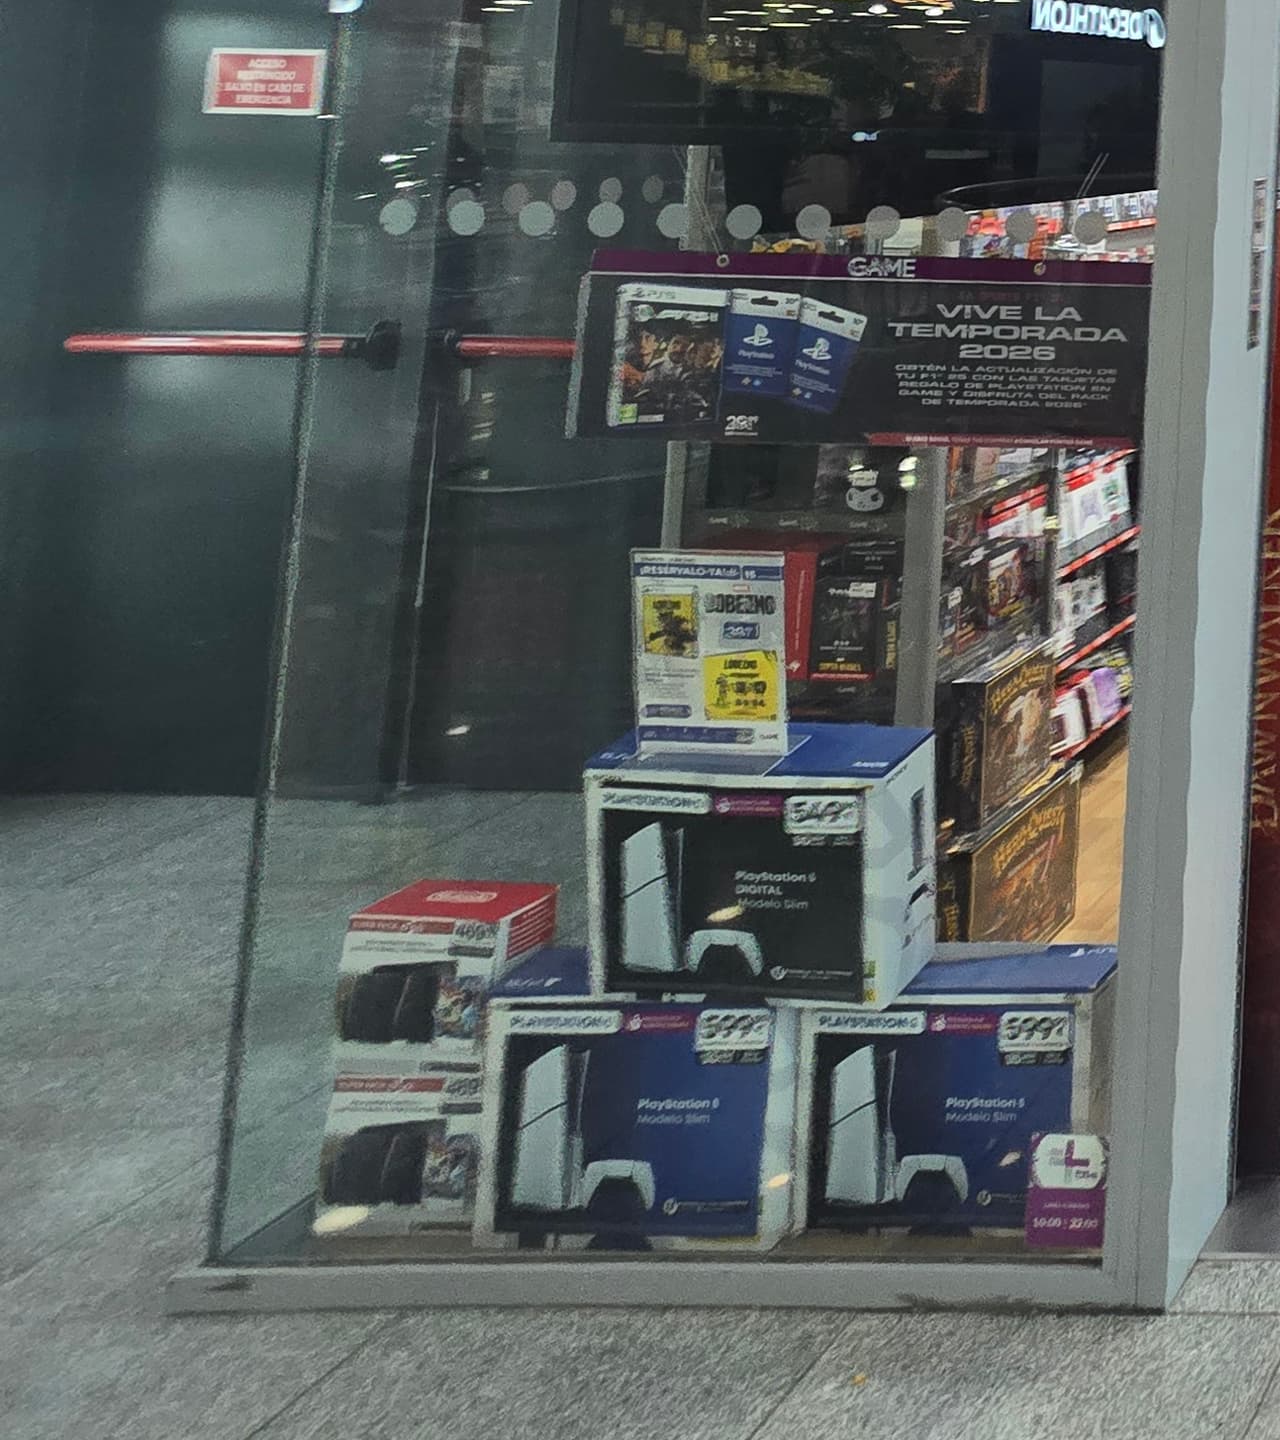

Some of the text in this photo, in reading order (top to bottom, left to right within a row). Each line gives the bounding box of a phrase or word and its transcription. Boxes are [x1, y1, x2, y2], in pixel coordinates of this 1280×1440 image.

[847, 256, 916, 279] GAME
[936, 303, 1083, 322] VIVE LA
[888, 322, 1129, 343] TEMPORADA
[958, 343, 1057, 360] 2026
[894, 363, 1119, 376] OBTÉN LA ACTUALIZACIÓN DE
[895, 372, 915, 380] TU
[972, 374, 1005, 382] CON
[1009, 375, 1039, 383] LAS
[1041, 375, 1117, 384] TARJETAS
[898, 380, 1112, 393] REGALO DE PLAYSTATION EN
[898, 389, 944, 397] GAME
[963, 390, 1033, 399] DISFRUTA
[1038, 392, 1067, 400] DEL
[1070, 392, 1110, 401] PACK
[922, 398, 943, 406] DE
[945, 398, 1041, 408] TEMPORADA
[734, 869, 806, 885] PlayStation
[735, 884, 783, 896] DIGITAL
[739, 897, 782, 910] Modelo
[637, 1097, 711, 1111] PlayStation
[945, 1096, 1017, 1110] PlayStation
